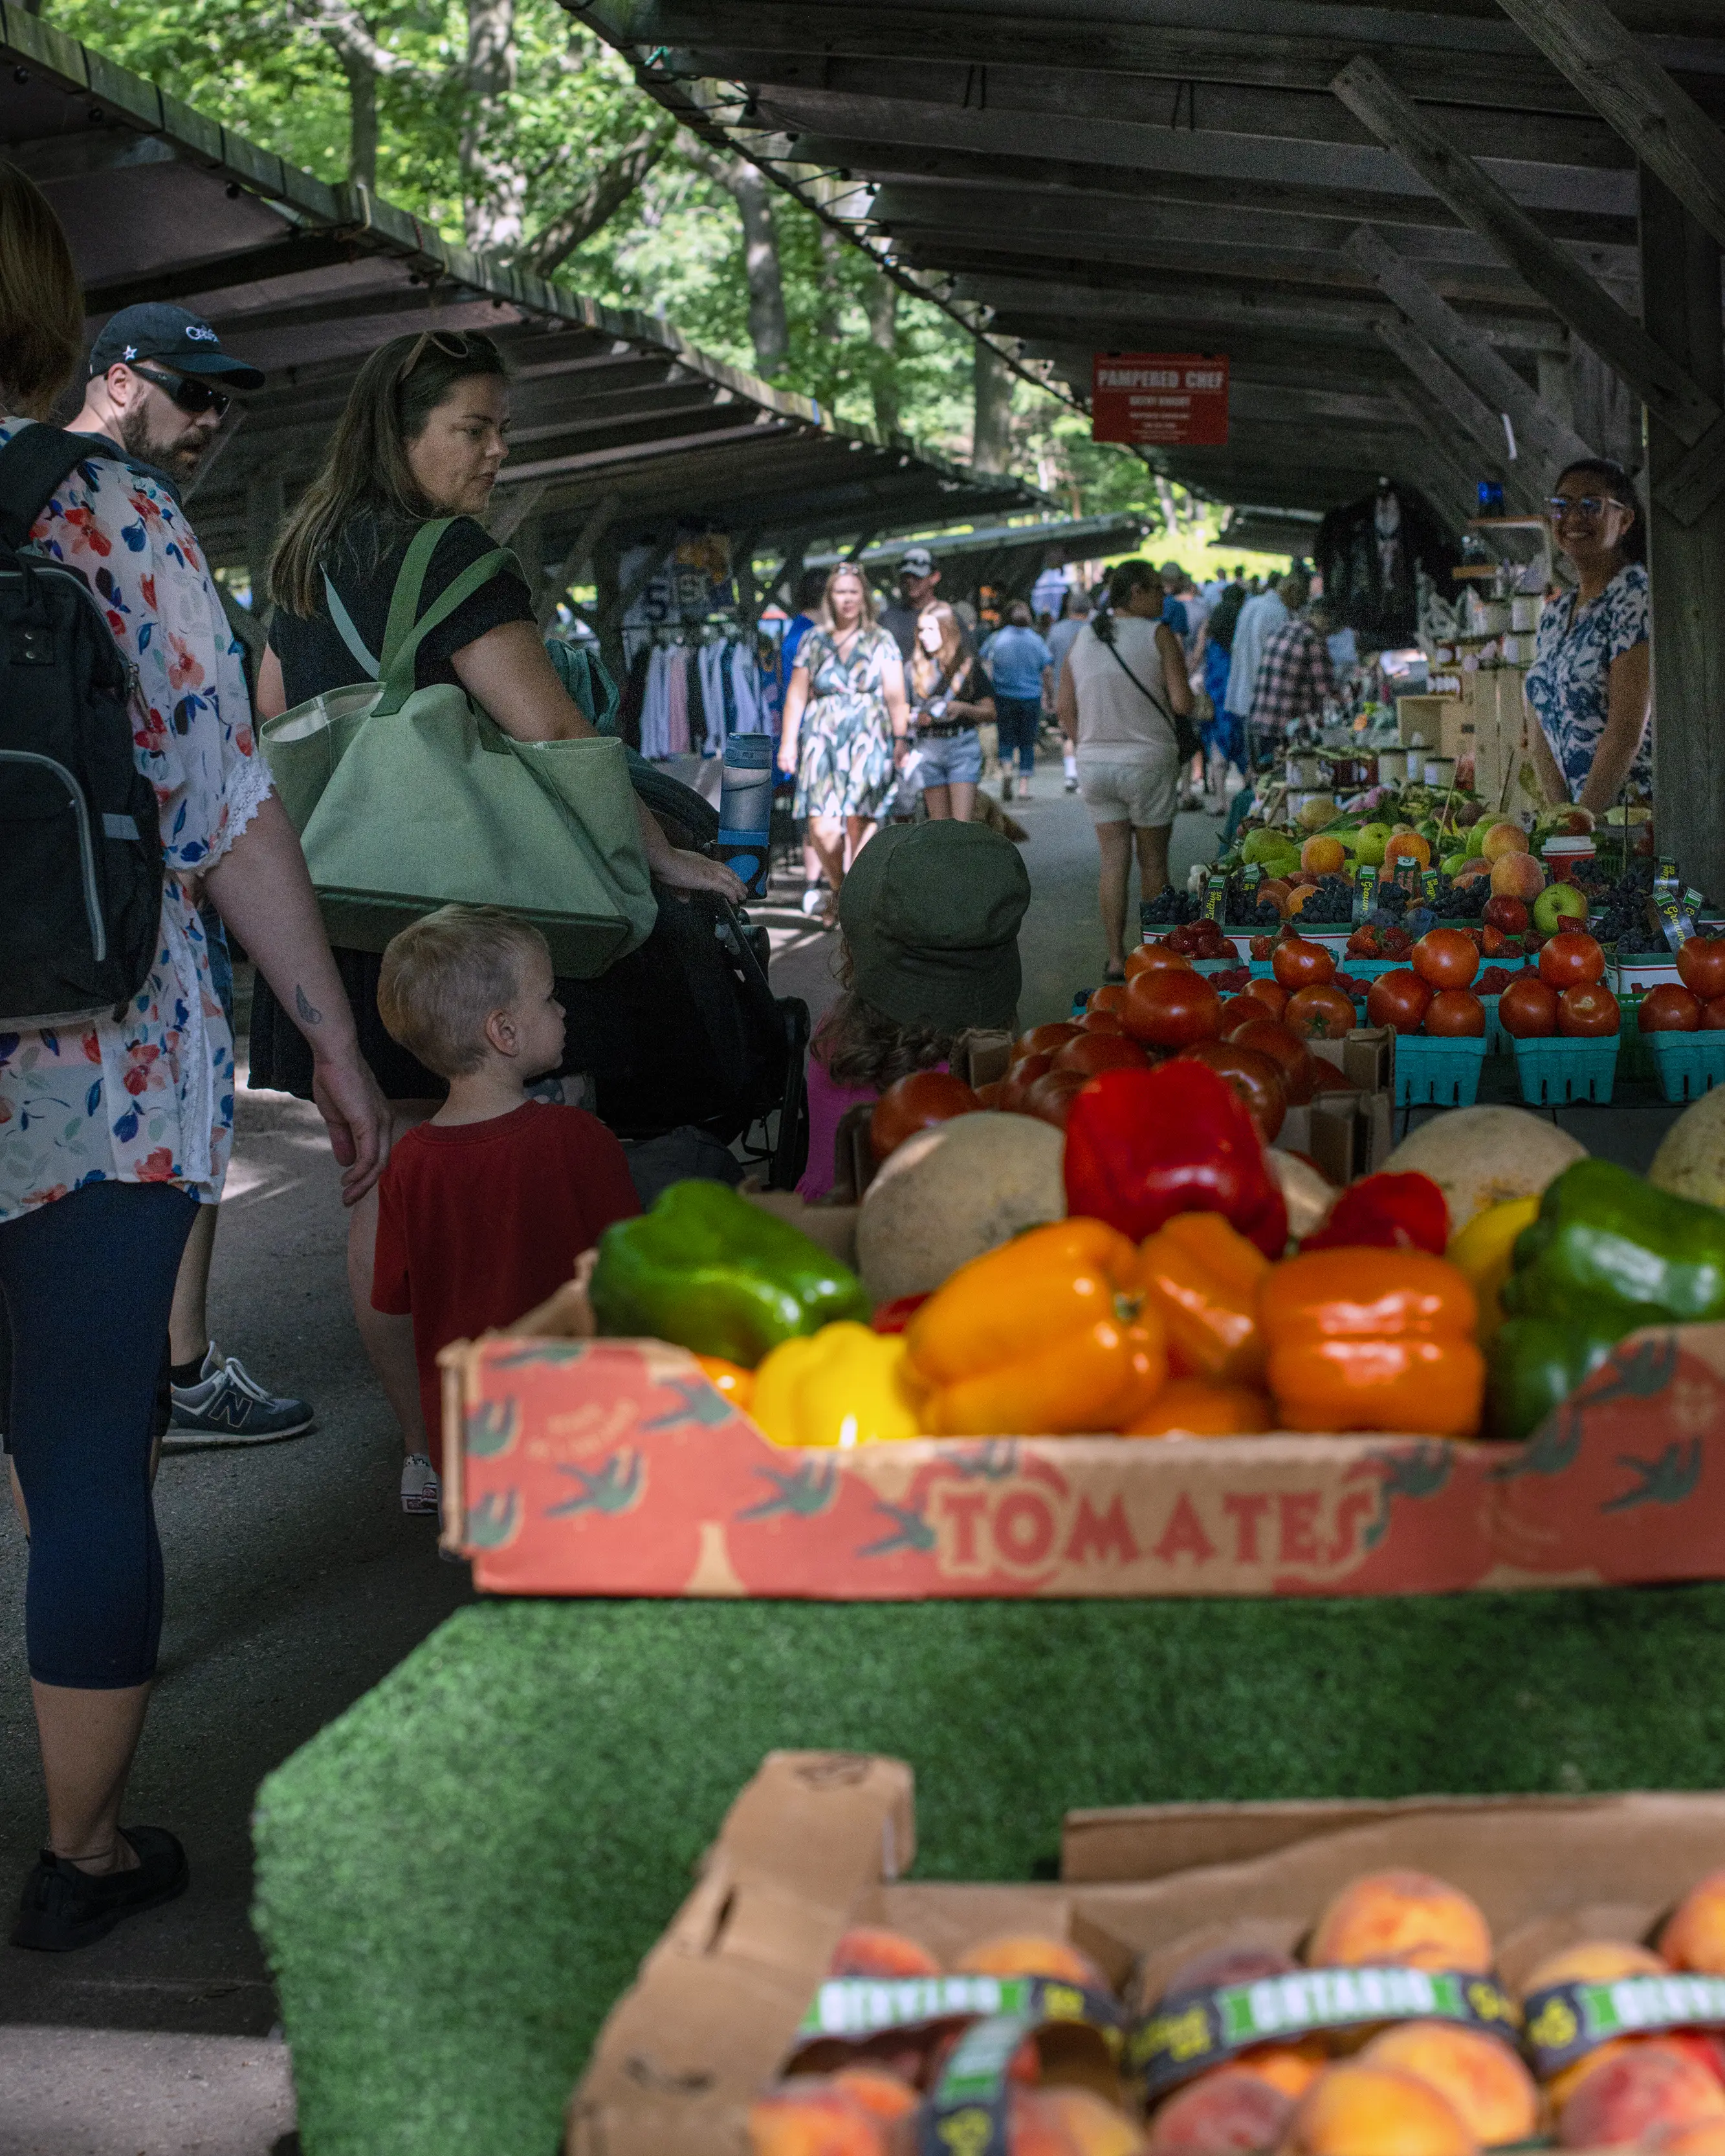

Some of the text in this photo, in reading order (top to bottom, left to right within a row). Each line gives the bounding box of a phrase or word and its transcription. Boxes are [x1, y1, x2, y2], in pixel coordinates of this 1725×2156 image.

[1097, 369, 1224, 389] PAMPERED CHEF
[207, 1388, 254, 1428] N
[940, 1490, 1374, 1565] TOMATES
